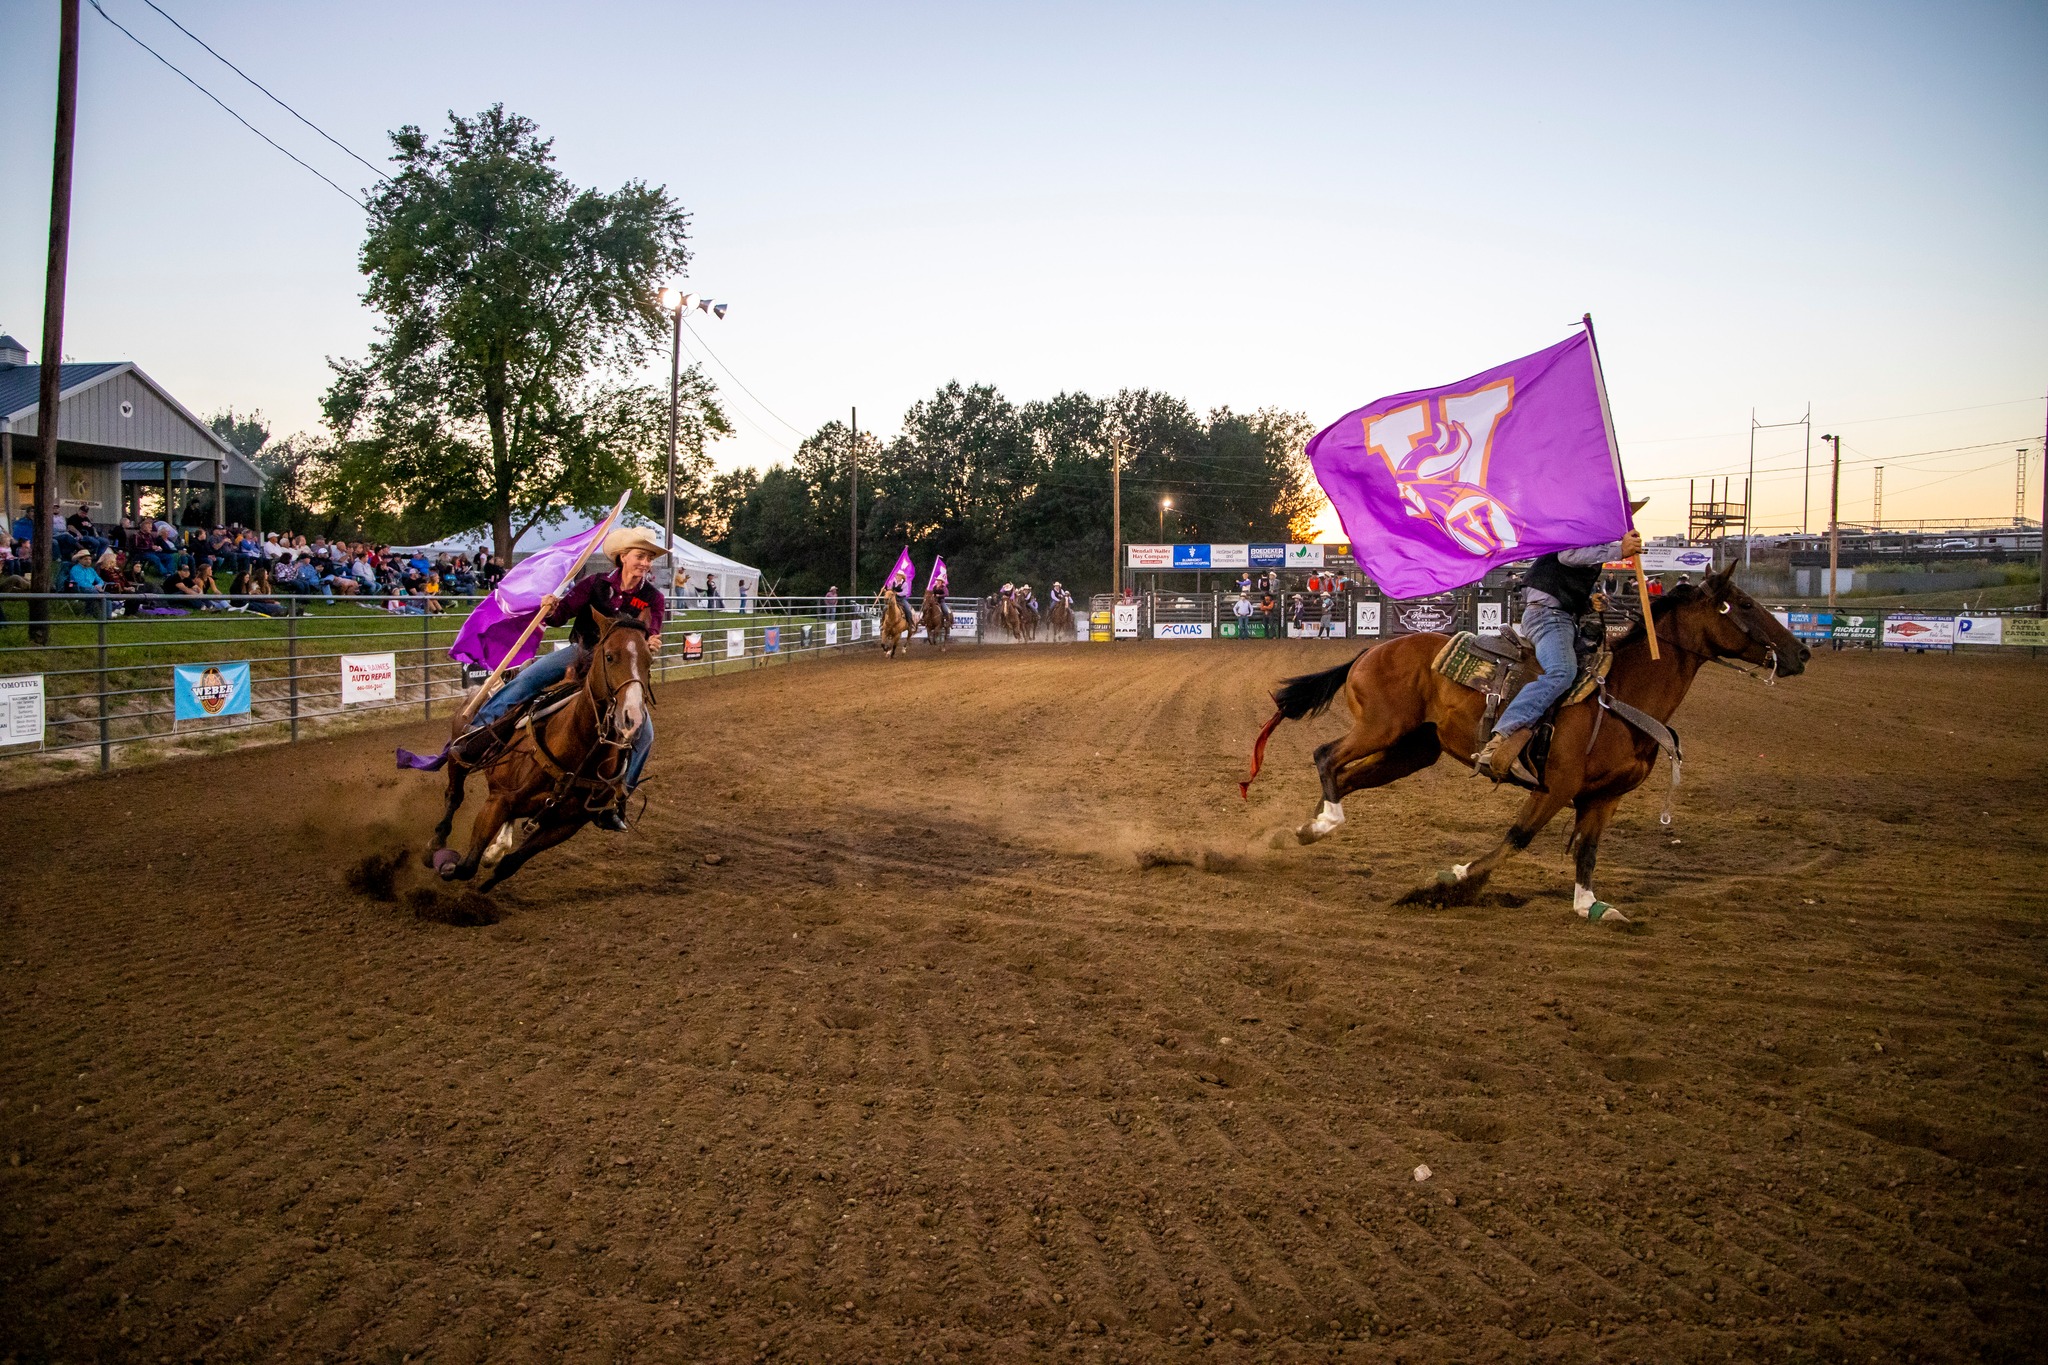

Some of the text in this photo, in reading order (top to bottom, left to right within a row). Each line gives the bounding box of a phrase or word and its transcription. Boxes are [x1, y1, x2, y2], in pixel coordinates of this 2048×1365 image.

[1173, 625, 1202, 634] CMAS
[371, 672, 391, 680] REPAIR
[0, 681, 38, 689] OMOTIVE
[192, 684, 234, 696] WEBER
